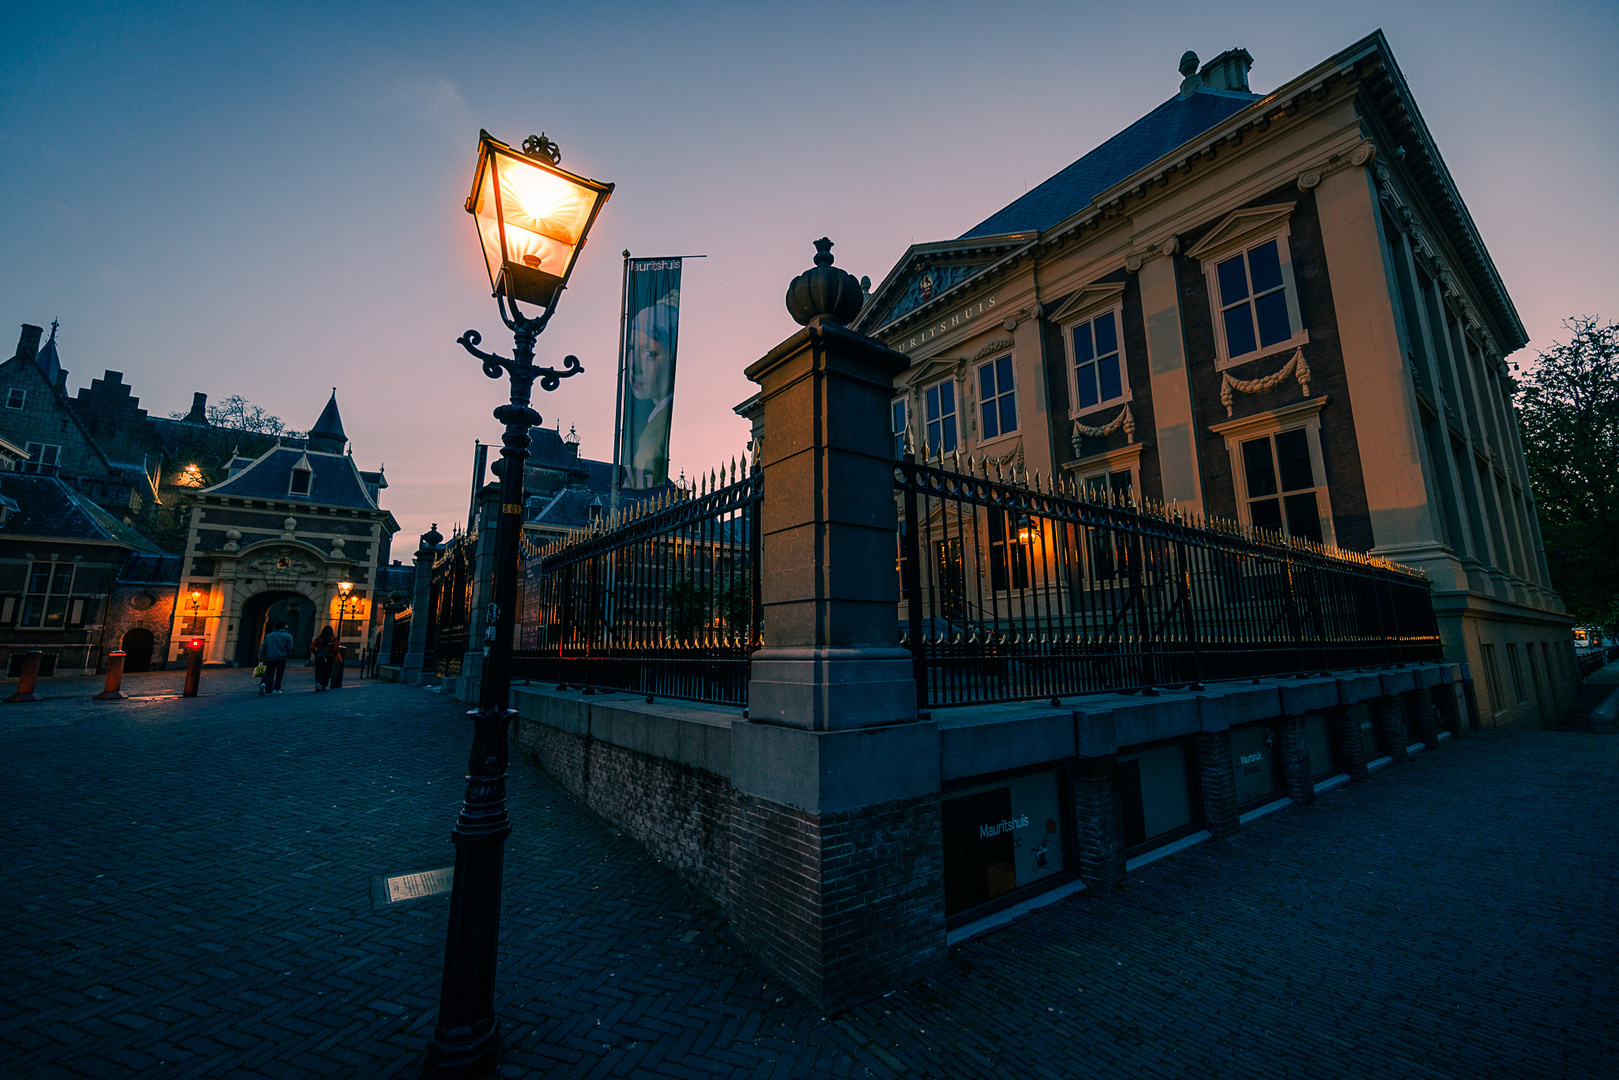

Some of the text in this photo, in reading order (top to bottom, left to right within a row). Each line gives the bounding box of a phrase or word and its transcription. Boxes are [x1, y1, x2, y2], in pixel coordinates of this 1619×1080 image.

[898, 296, 996, 353] URITSHUIS
[503, 504, 519, 514] 501
[979, 814, 1029, 840] Mauritshuis
